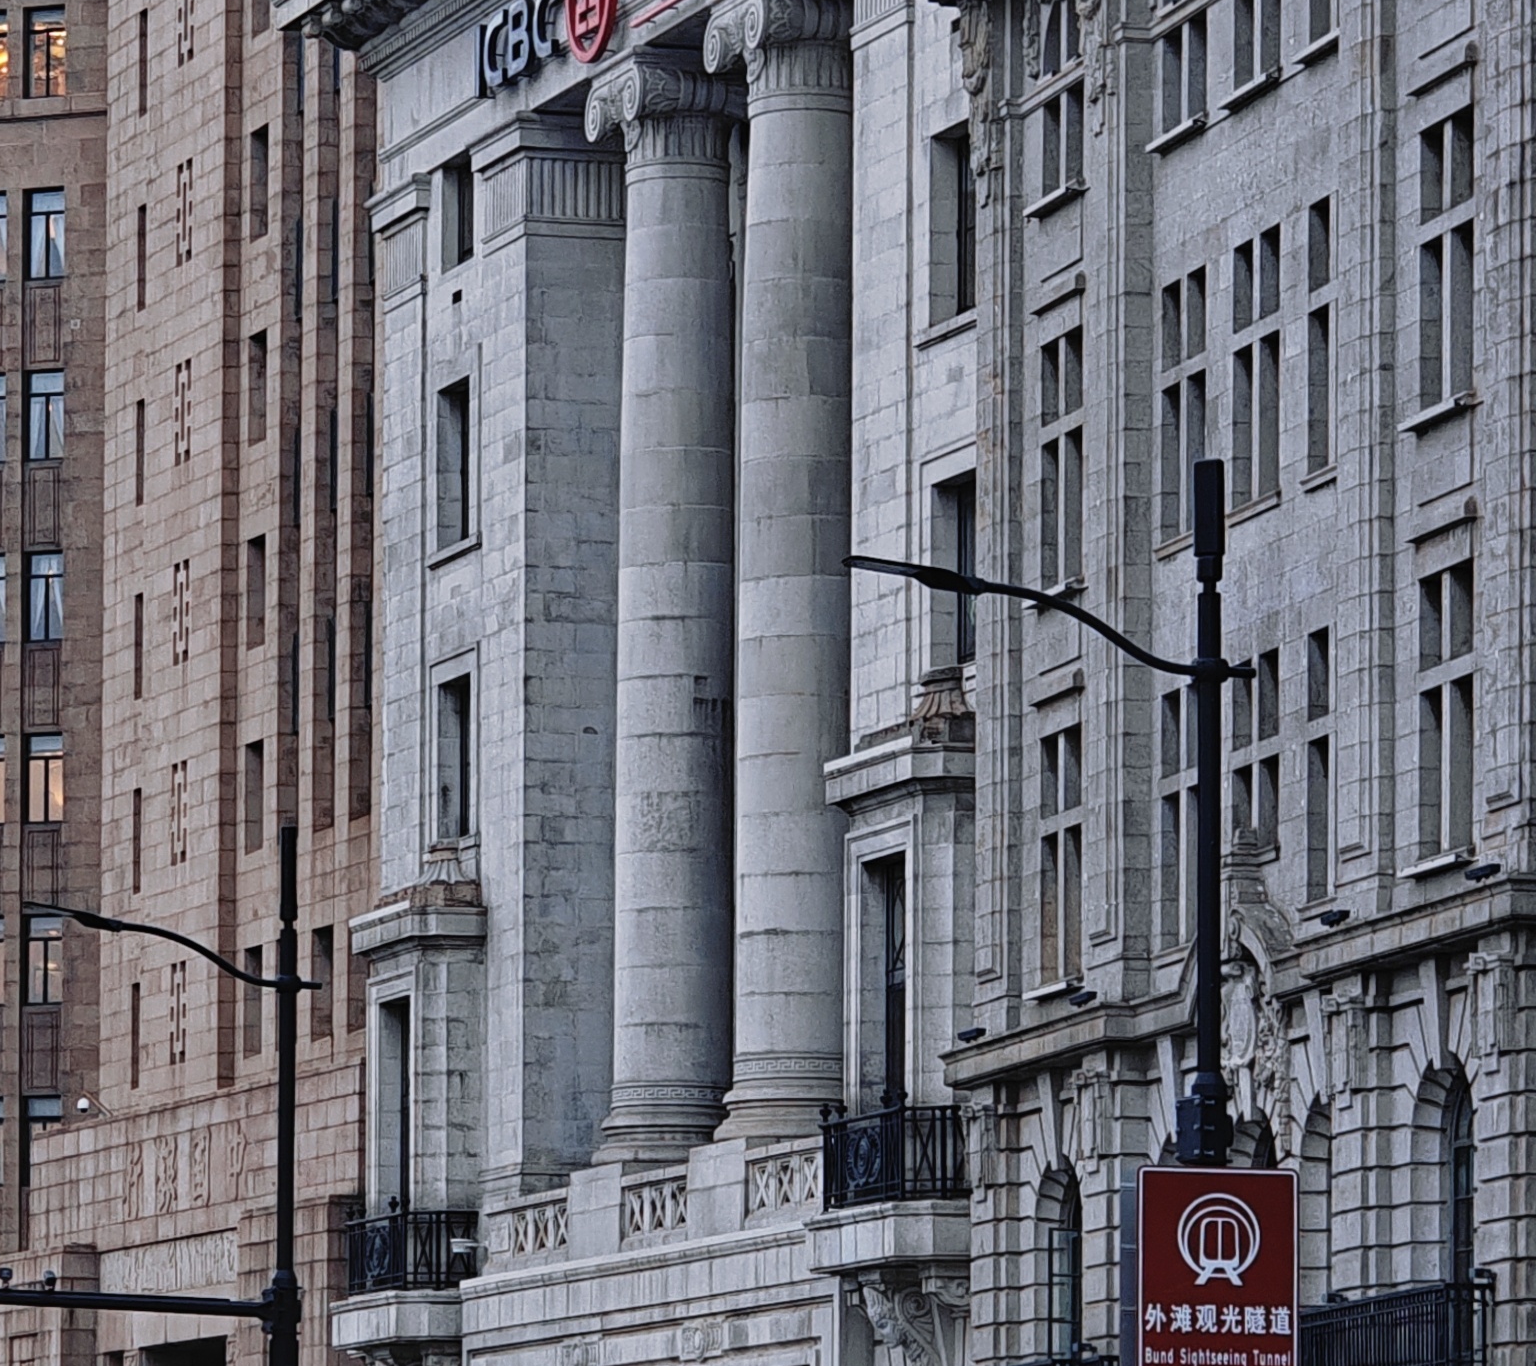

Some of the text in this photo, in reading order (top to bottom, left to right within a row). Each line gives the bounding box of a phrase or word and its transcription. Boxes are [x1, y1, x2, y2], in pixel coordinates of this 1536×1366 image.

[1144, 1303, 1292, 1335] 外滩观光隧道
[1144, 1347, 1174, 1365] Bund
